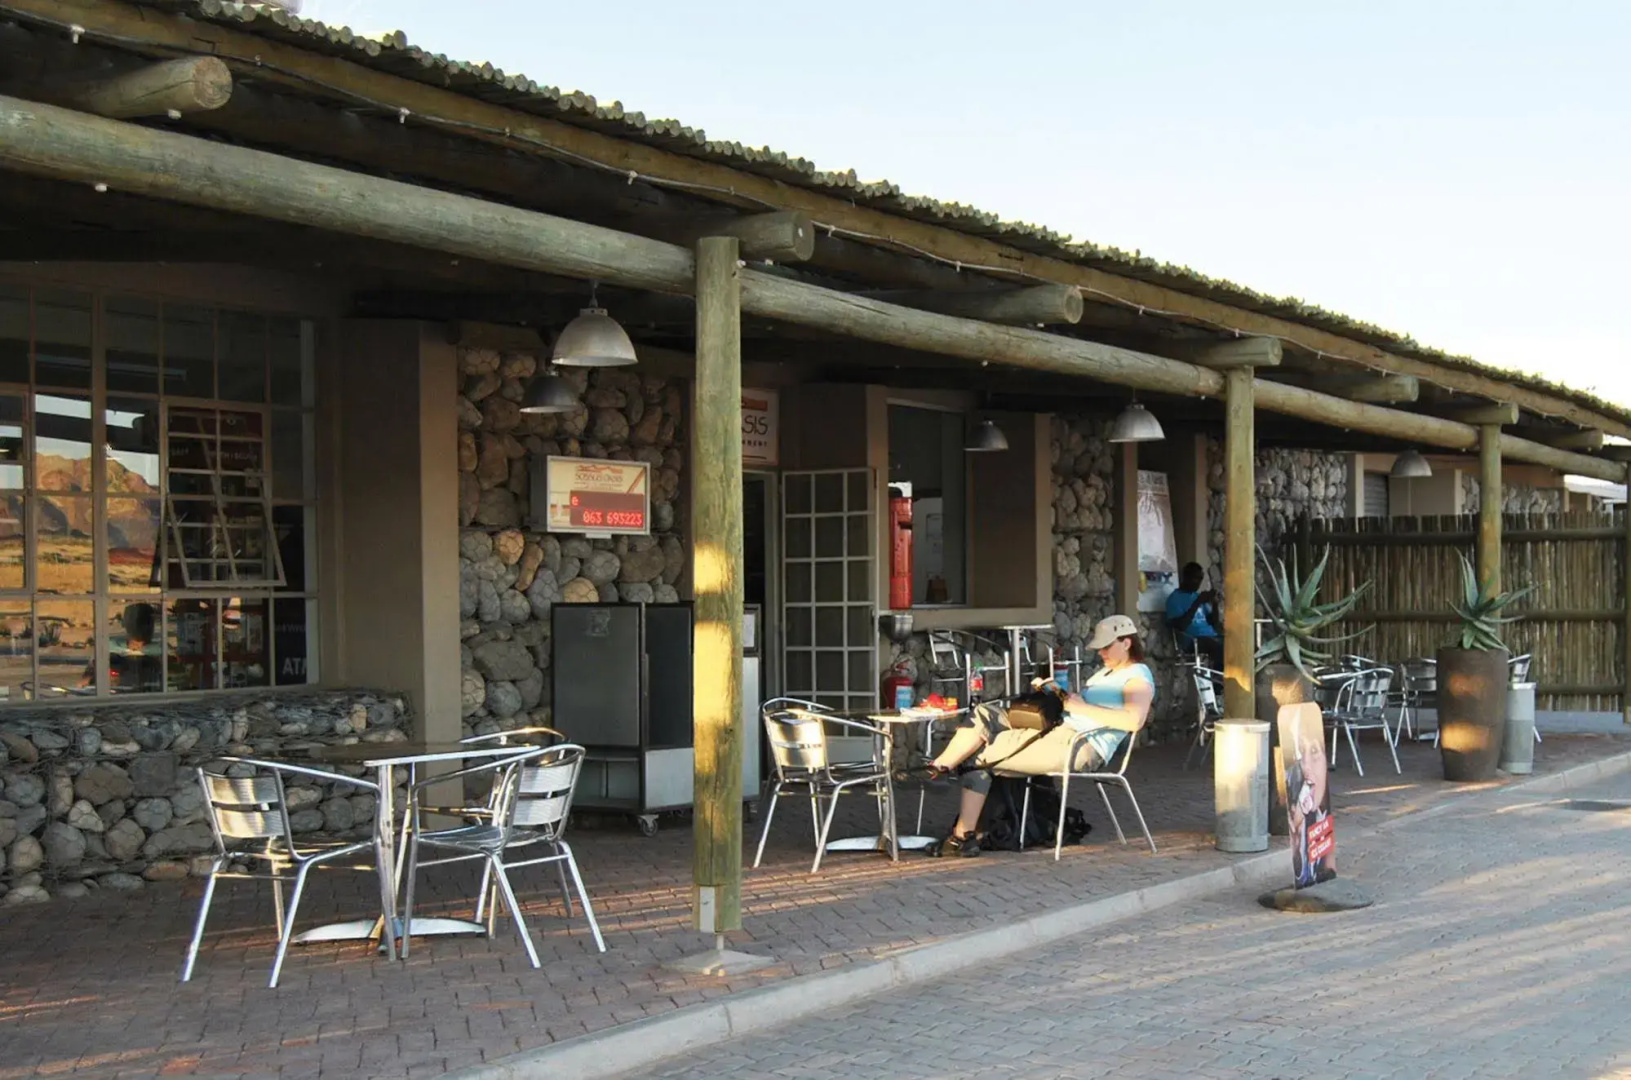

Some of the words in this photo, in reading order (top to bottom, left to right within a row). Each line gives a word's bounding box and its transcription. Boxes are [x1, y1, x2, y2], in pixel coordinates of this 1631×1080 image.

[742, 415, 768, 435] SIS
[583, 511, 602, 524] 063
[606, 511, 643, 526] 693223
